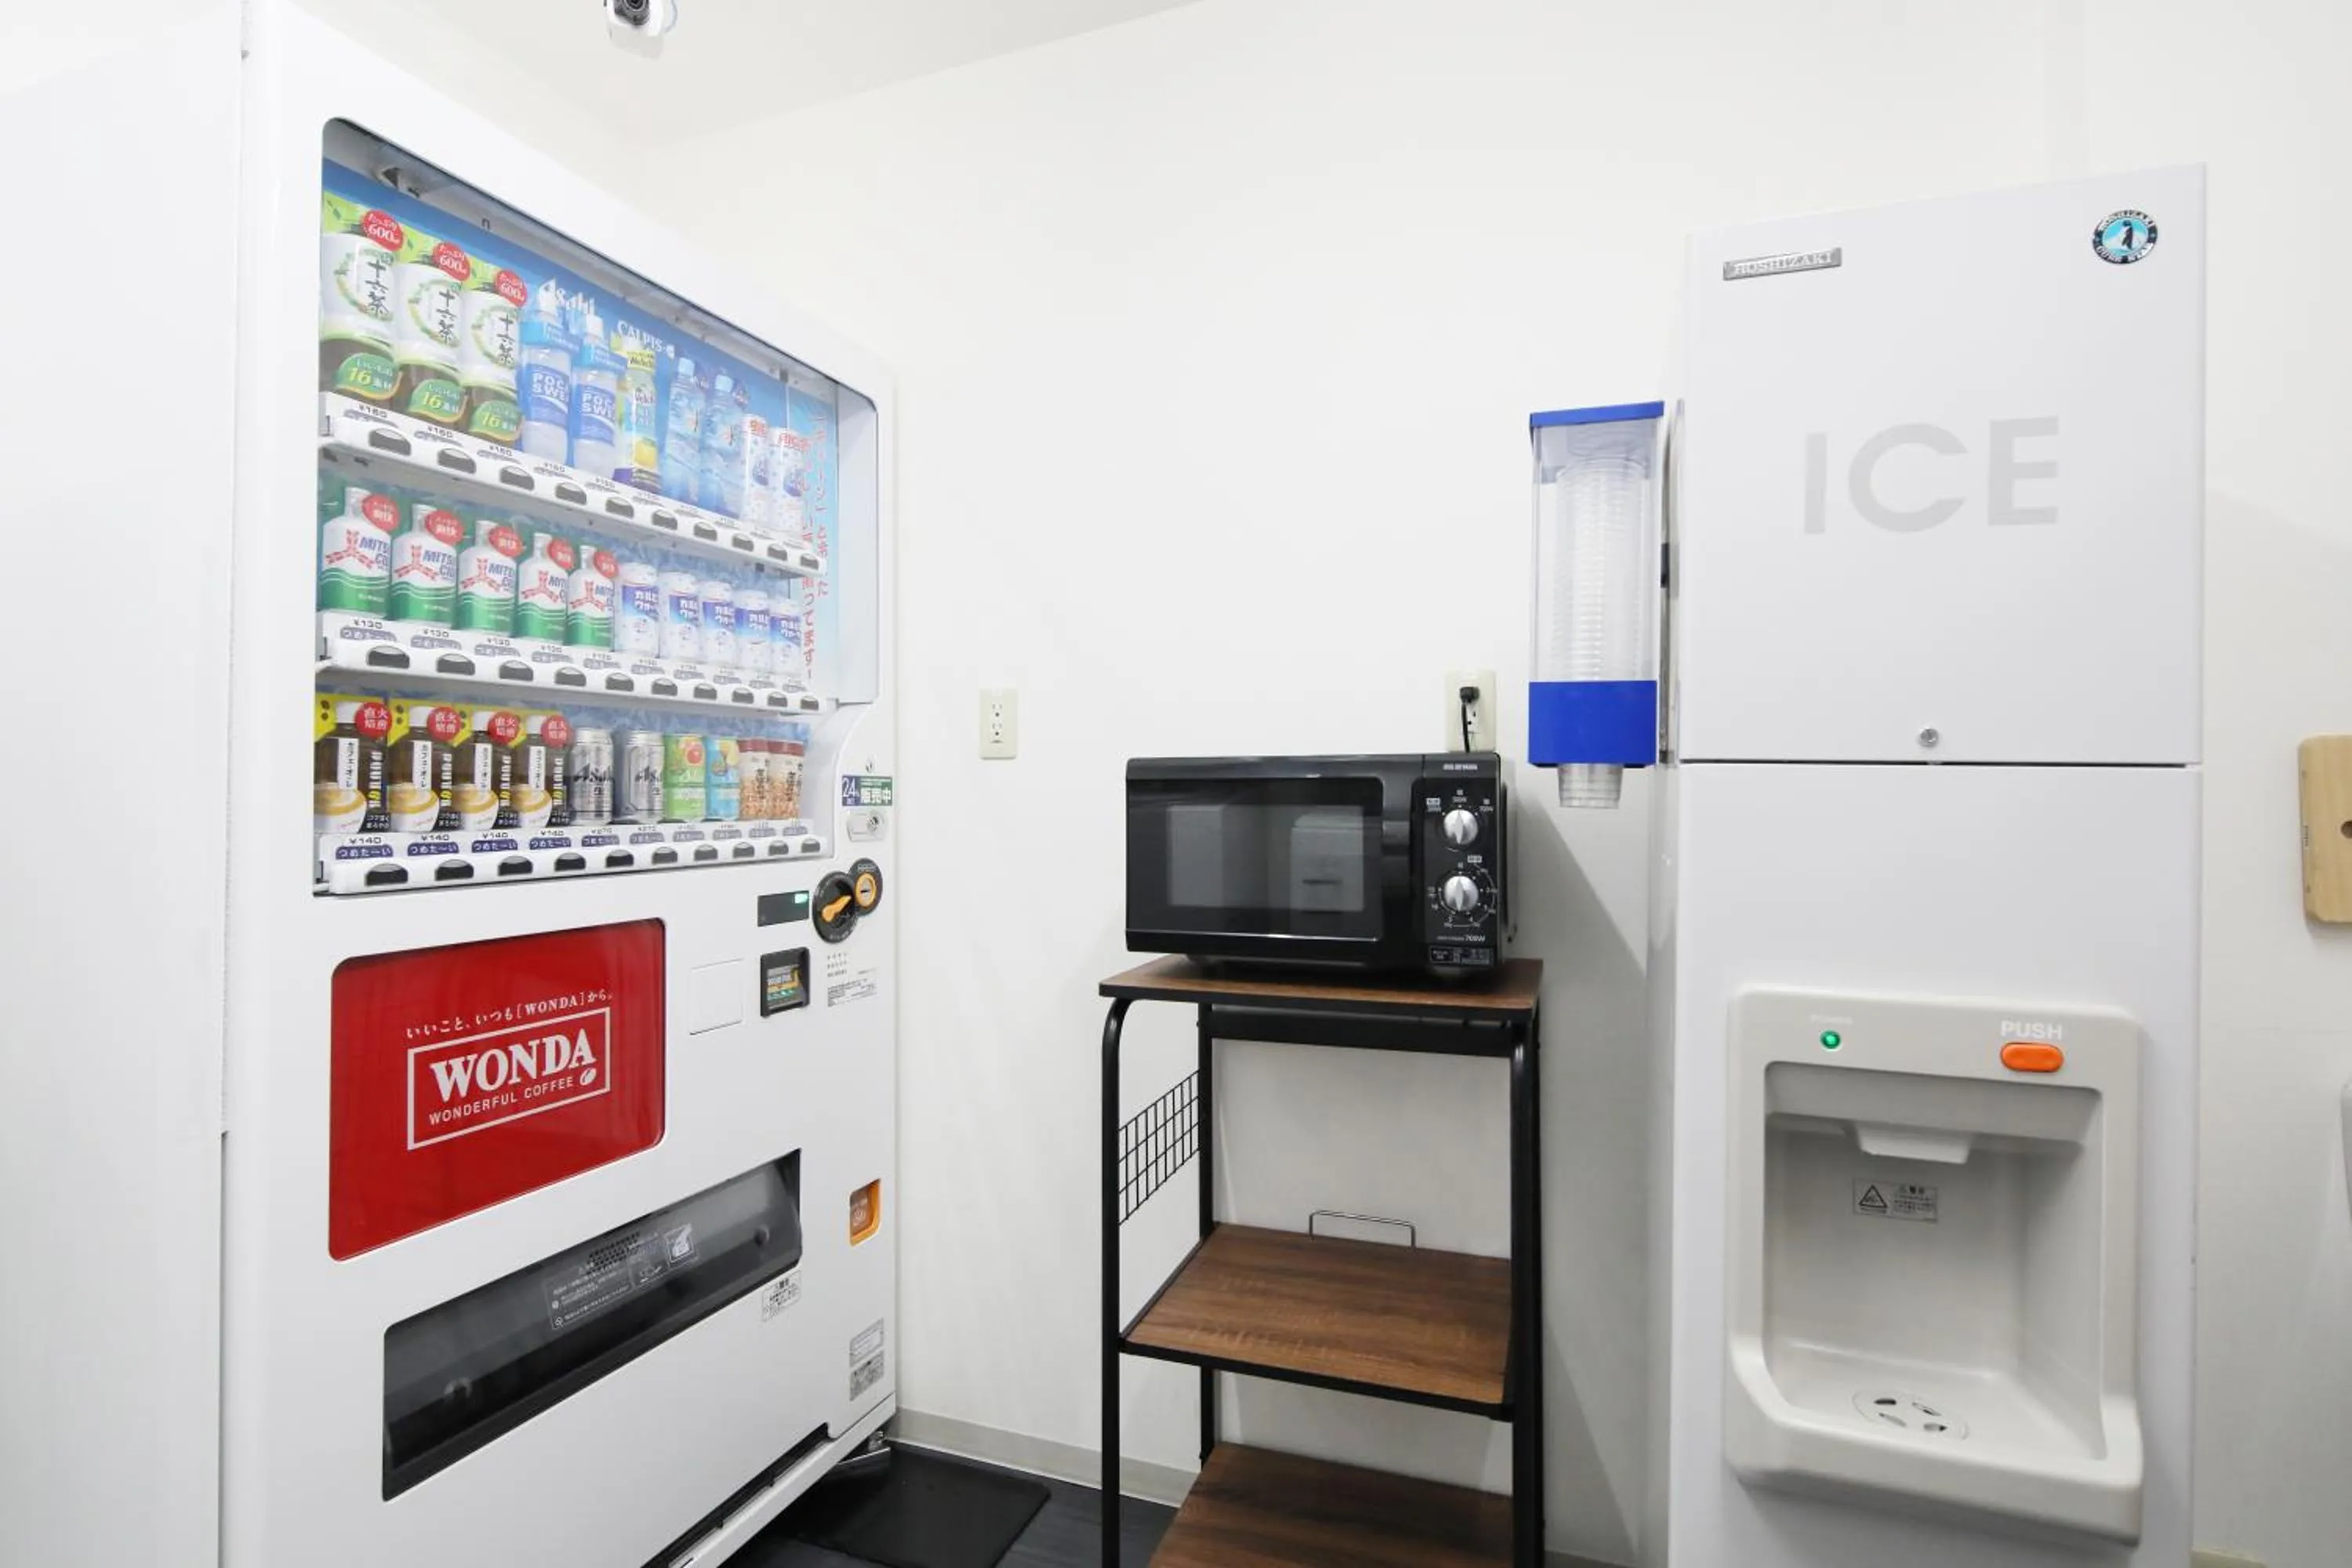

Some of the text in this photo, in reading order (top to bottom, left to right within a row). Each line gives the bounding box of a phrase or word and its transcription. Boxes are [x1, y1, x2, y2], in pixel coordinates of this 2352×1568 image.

[1804, 415, 2059, 535] ICE
[2001, 1020, 2063, 1040] PUSH
[430, 1028, 597, 1103] WONDA
[429, 1076, 574, 1125] WONDERFUL COFFEE
